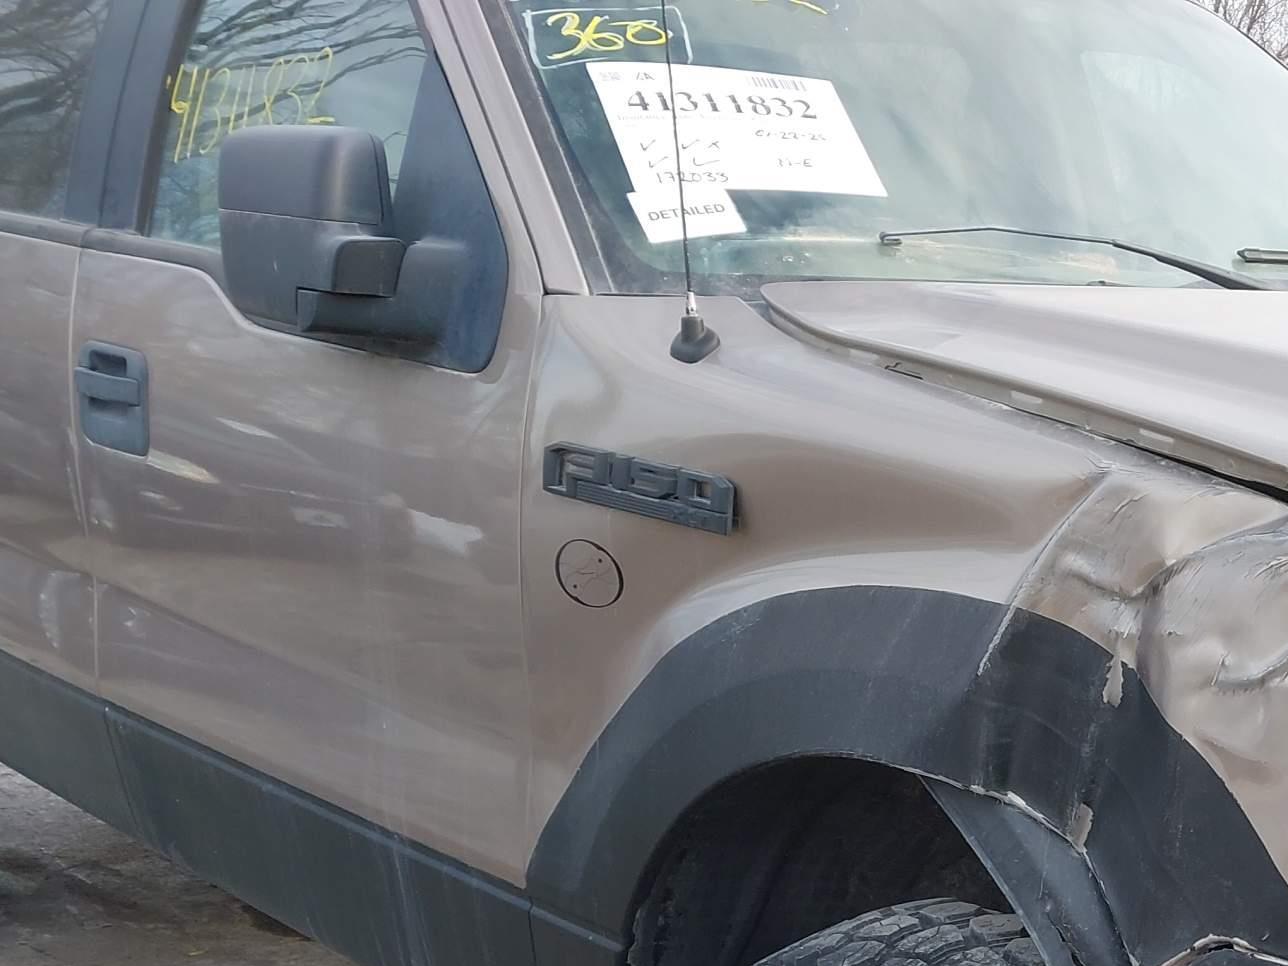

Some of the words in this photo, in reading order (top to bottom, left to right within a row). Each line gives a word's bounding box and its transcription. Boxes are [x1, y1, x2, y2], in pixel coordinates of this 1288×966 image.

[546, 13, 668, 59] 360
[627, 90, 818, 119] 41311832
[647, 202, 726, 221] DETAILED
